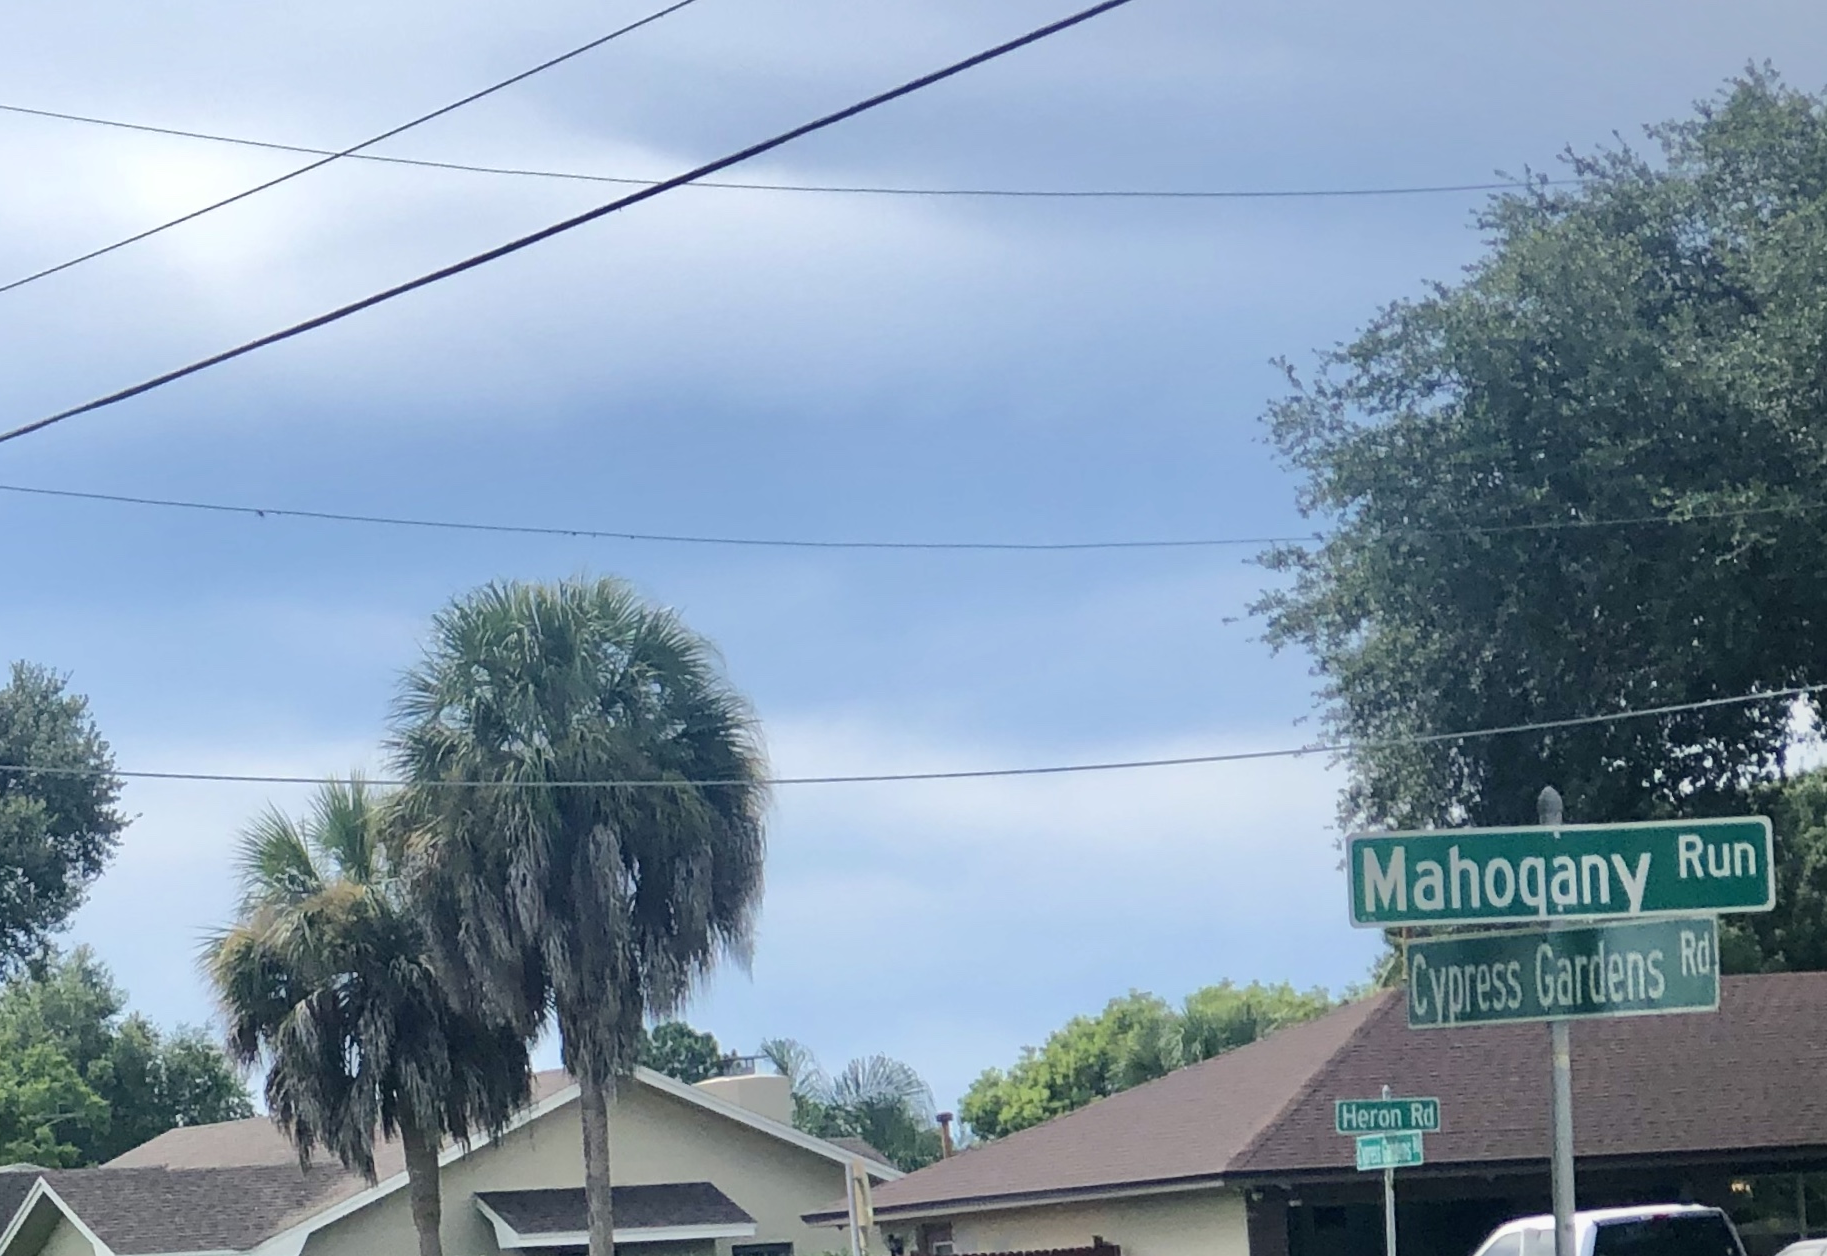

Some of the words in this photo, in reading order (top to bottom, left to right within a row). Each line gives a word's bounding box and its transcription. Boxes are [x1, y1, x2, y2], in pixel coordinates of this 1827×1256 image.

[1362, 845, 1652, 917] Mahogany
[1677, 833, 1758, 879] Run
[1410, 952, 1522, 1024] Cypress
[1535, 942, 1666, 1008] Gardens
[1681, 929, 1711, 977] Rd
[1342, 1103, 1403, 1129] Heron
[1410, 1102, 1435, 1127] Rd
